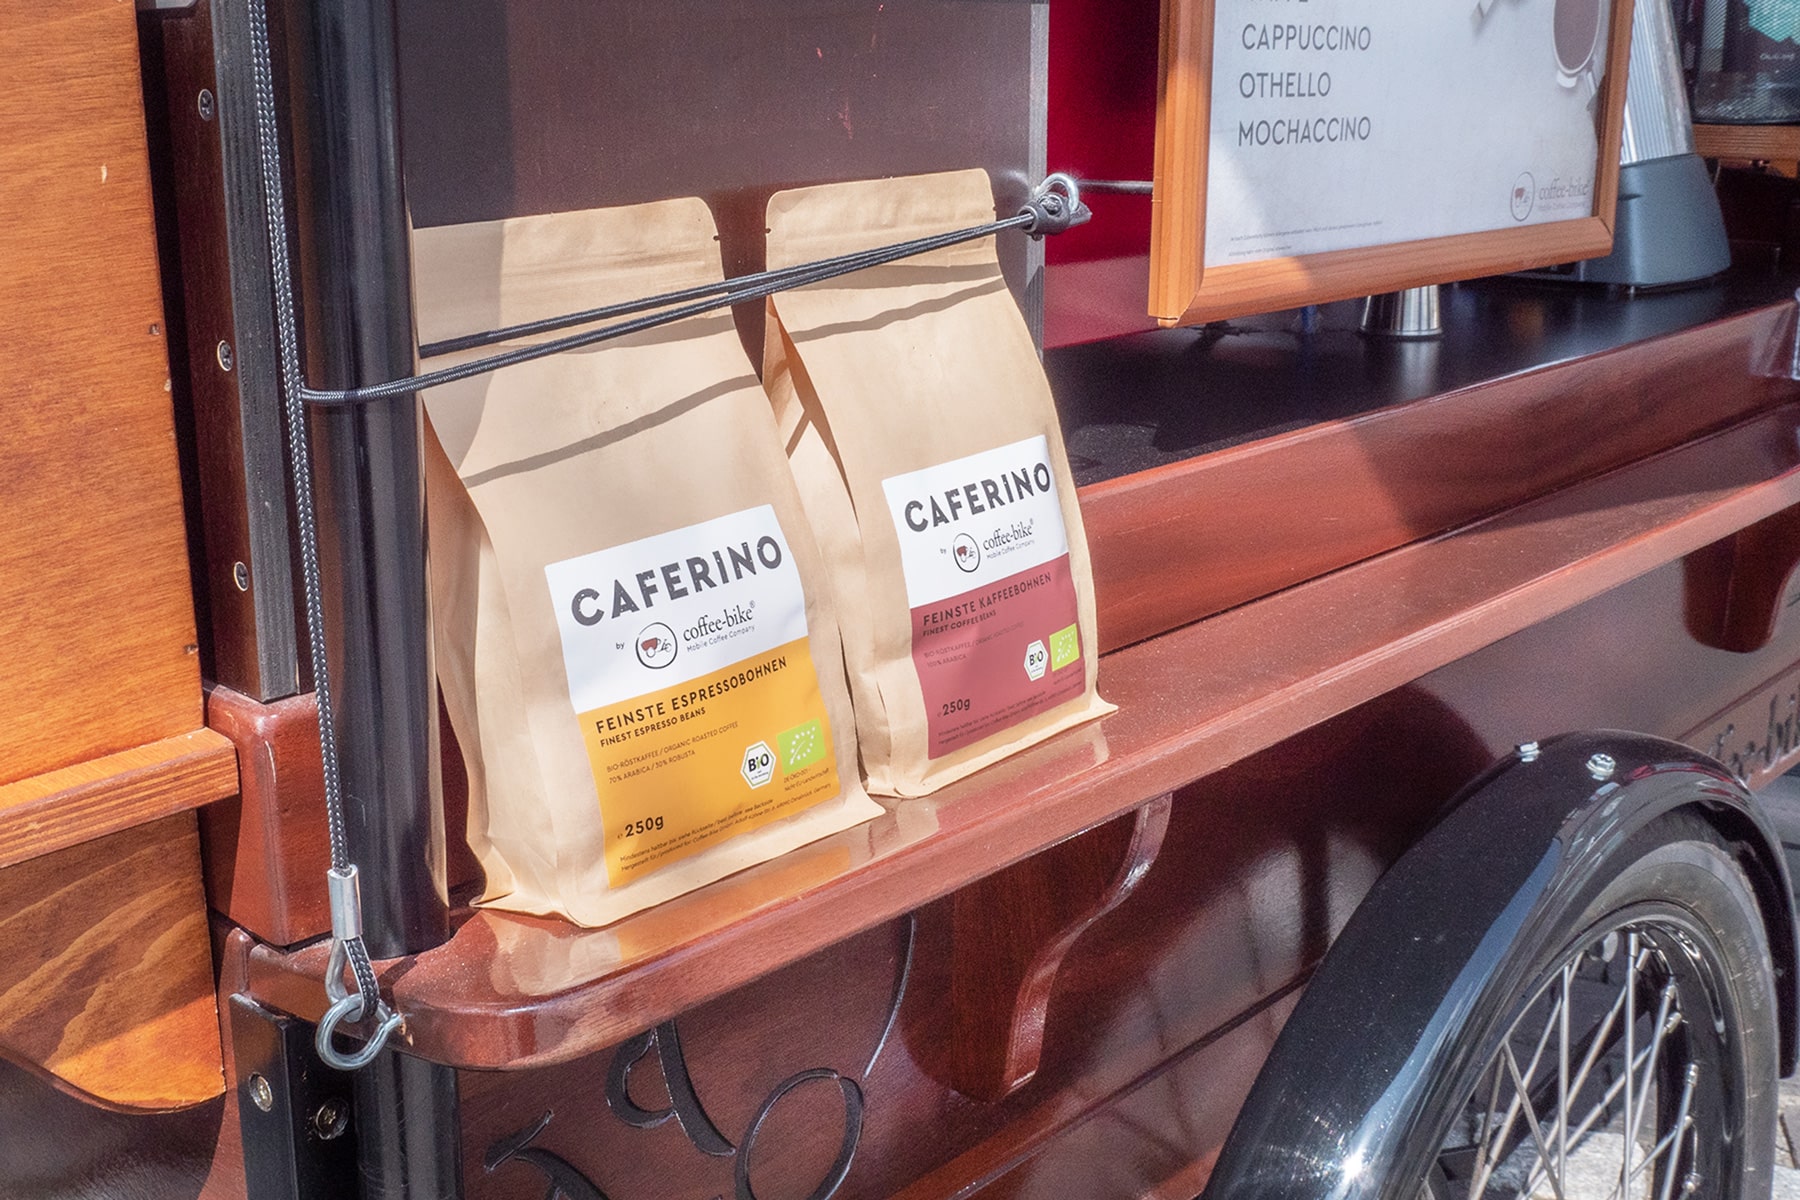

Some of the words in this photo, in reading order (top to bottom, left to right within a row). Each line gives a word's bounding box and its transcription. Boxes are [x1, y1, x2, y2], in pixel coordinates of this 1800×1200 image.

[1242, 23, 1371, 51] CAPPUCCINO
[1239, 72, 1331, 98] OTHELLO
[1238, 116, 1371, 147] MOCHACCINO
[905, 462, 1051, 533] CAFERINO
[571, 535, 783, 627] CAFERINO
[922, 600, 976, 626] FEINSTE
[978, 572, 1051, 609] KAFFEEBOHNEN
[708, 632, 728, 645] Coffee
[922, 624, 948, 636] FINEST
[950, 616, 978, 629] COFFEE
[615, 641, 625, 650] by
[595, 701, 665, 734] FEINSTE
[671, 655, 787, 710] ESPRESSOBOHNEN
[600, 730, 632, 747] FINEST
[633, 715, 678, 737] ESPRESSO
[679, 706, 705, 721] BEANS
[718, 720, 738, 733] COFFEE
[668, 748, 695, 763] ROBUSTA
[625, 813, 664, 838] 250g
